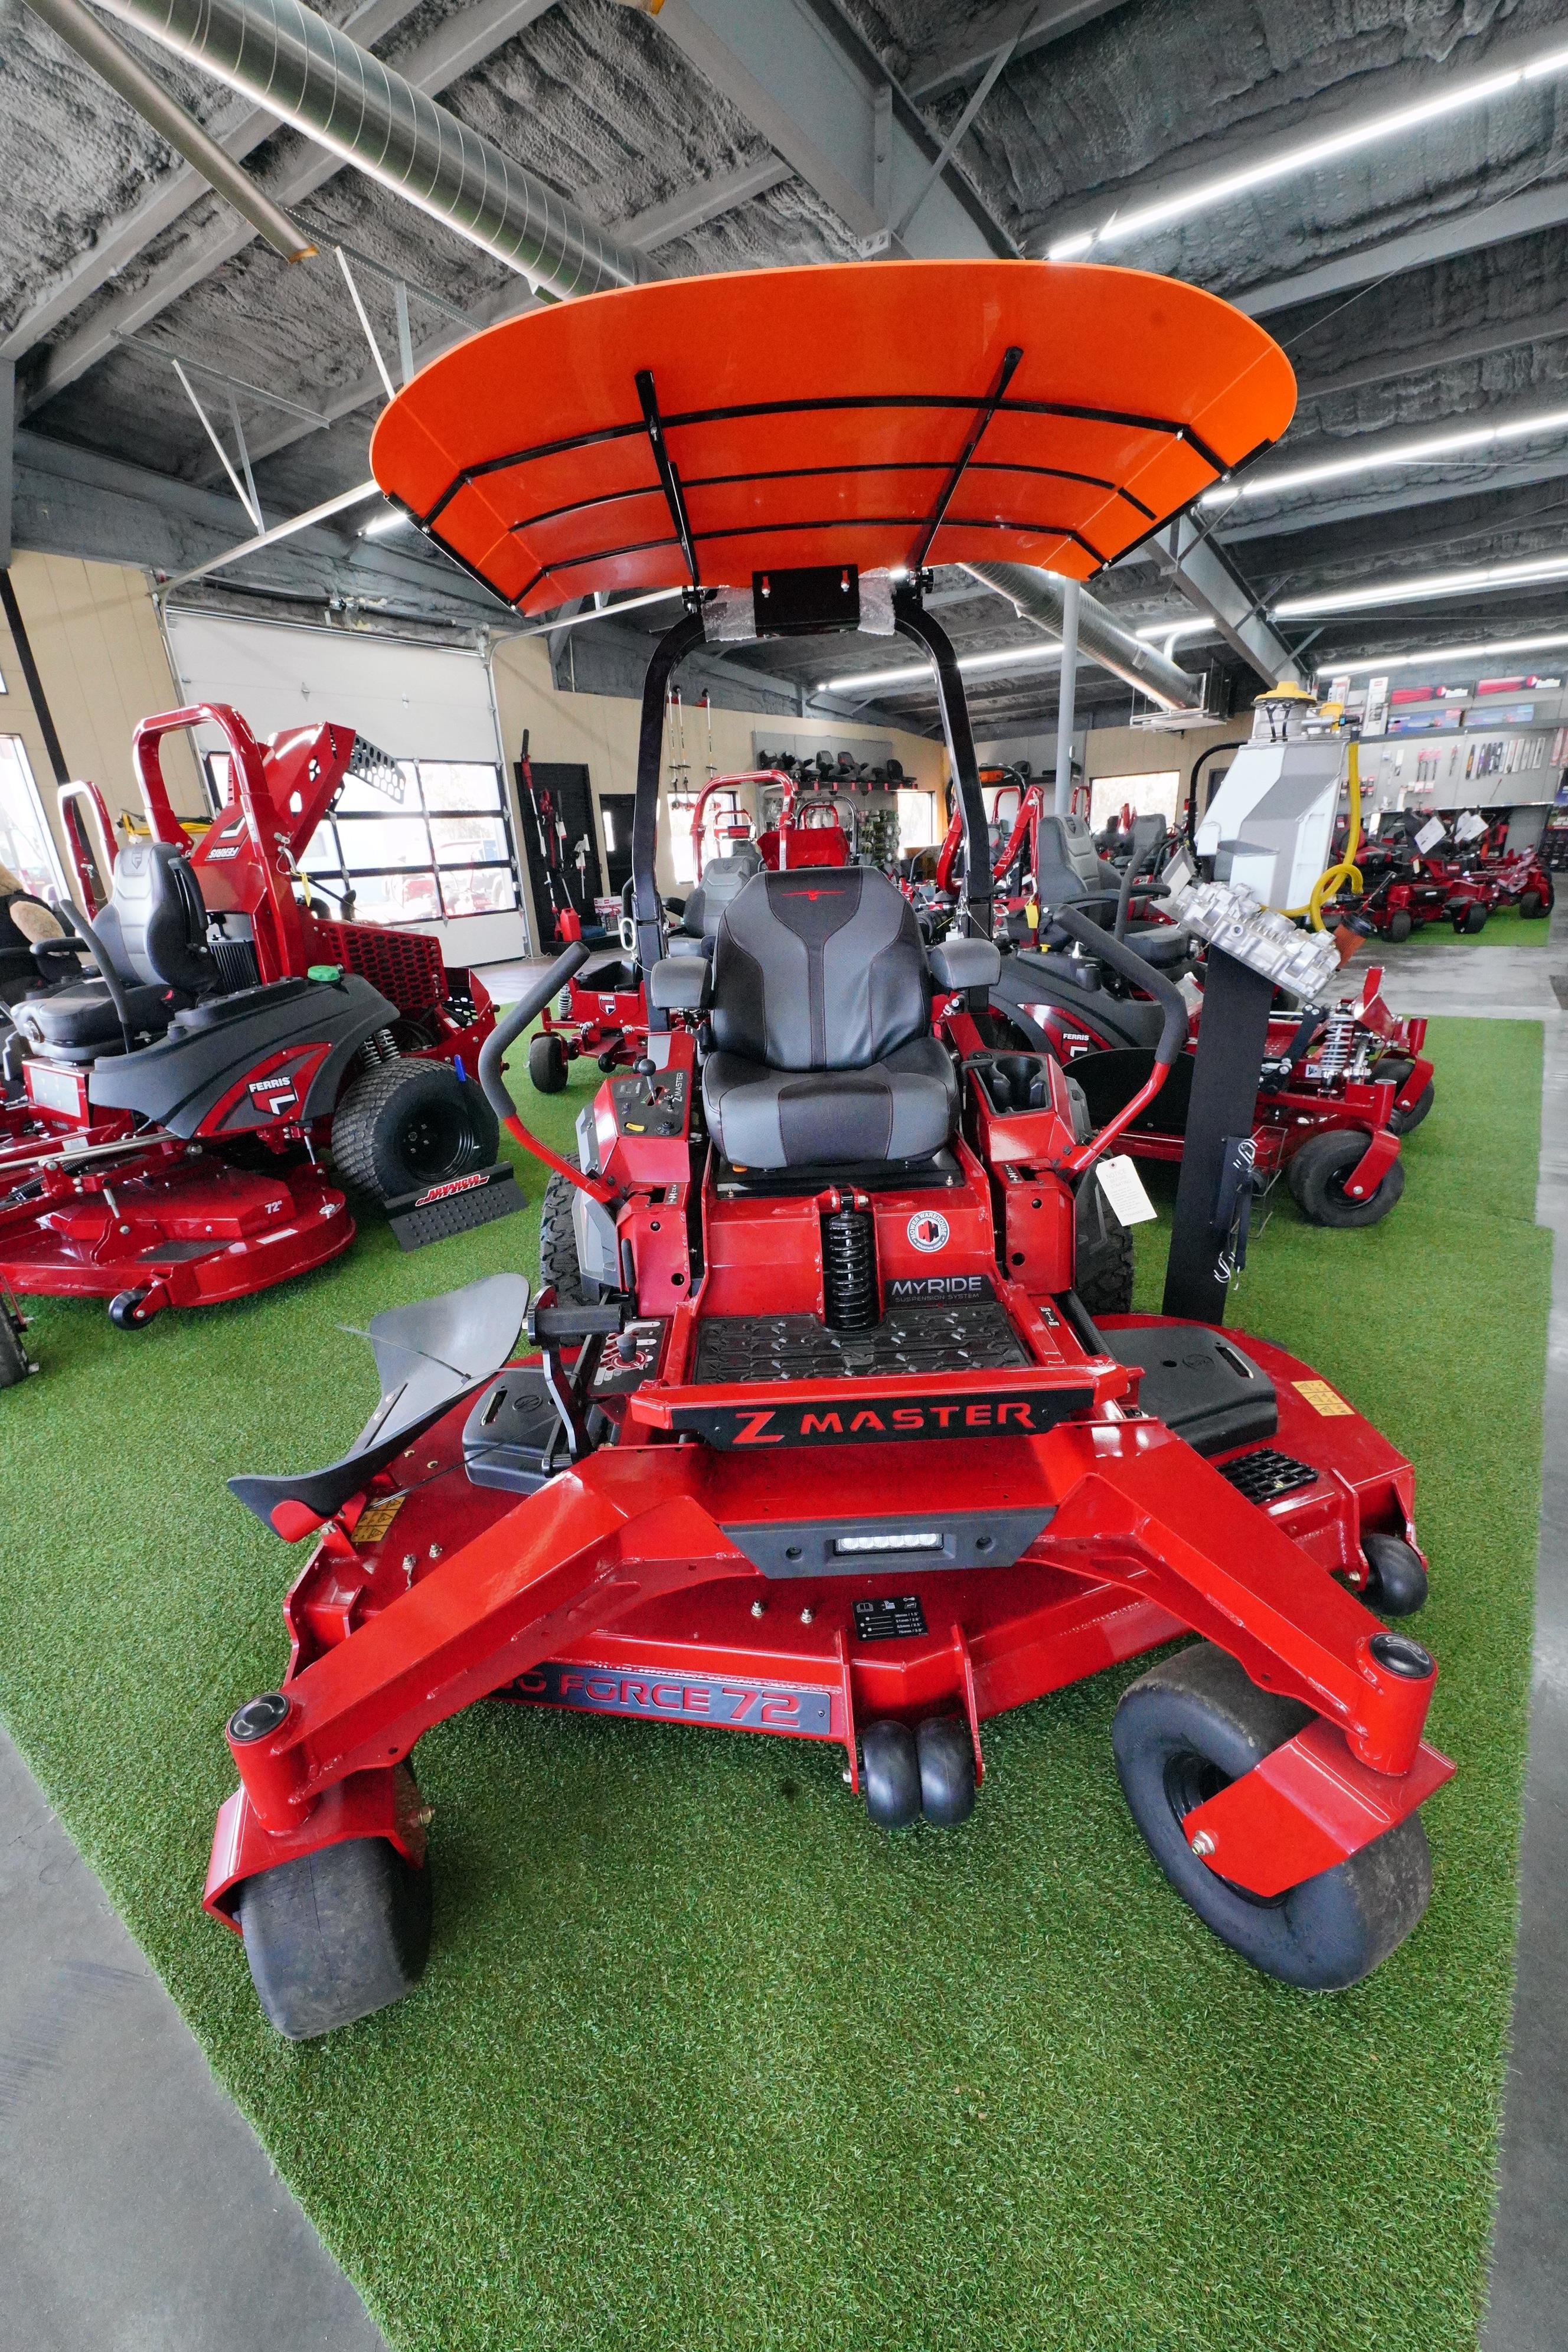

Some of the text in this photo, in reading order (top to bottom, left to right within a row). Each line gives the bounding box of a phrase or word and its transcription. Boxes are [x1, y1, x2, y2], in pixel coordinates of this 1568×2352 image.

[208, 847, 239, 858] FERRIS
[249, 1076, 290, 1093] FERRIS
[674, 1072, 684, 1096] MASTER
[428, 1174, 481, 1197] ADVANCED
[910, 1212, 947, 1239] MOWER WAREHOUSE
[733, 1402, 1036, 1443] Z MASTER
[558, 1673, 710, 1713] FORCE
[722, 1686, 800, 1727] 72
